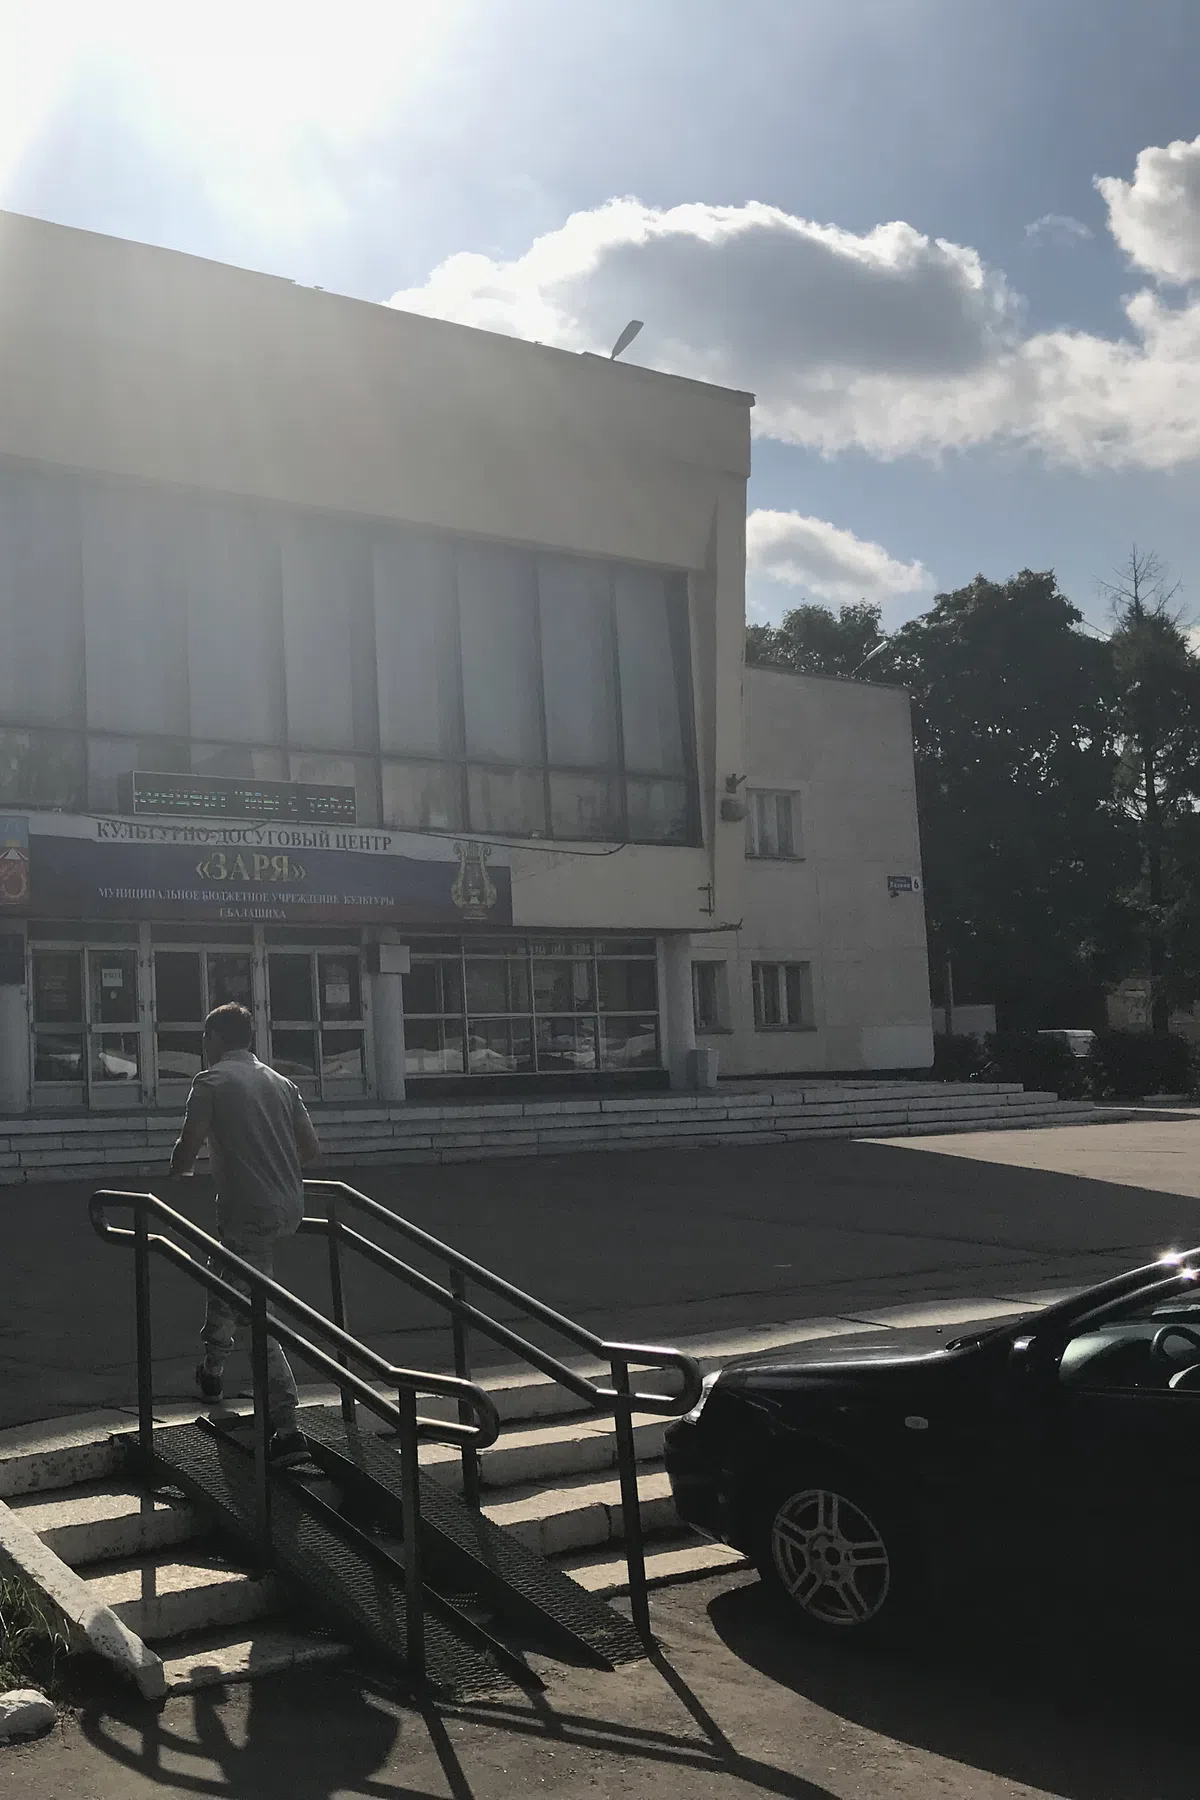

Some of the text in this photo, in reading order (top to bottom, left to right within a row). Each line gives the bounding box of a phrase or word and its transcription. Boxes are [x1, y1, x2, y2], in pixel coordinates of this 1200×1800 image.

[97, 821, 392, 851] КУЛЬТУРНО-ДОСУГОВЫЙ ЦЕНТР
[195, 851, 307, 882] «ЗАРЯ»
[98, 887, 200, 901] МУНИЦИПАЛЬНОЕ
[202, 890, 269, 903] БЮДЖЕТНОЕ
[343, 894, 395, 906] КУЛЬТУРЫ
